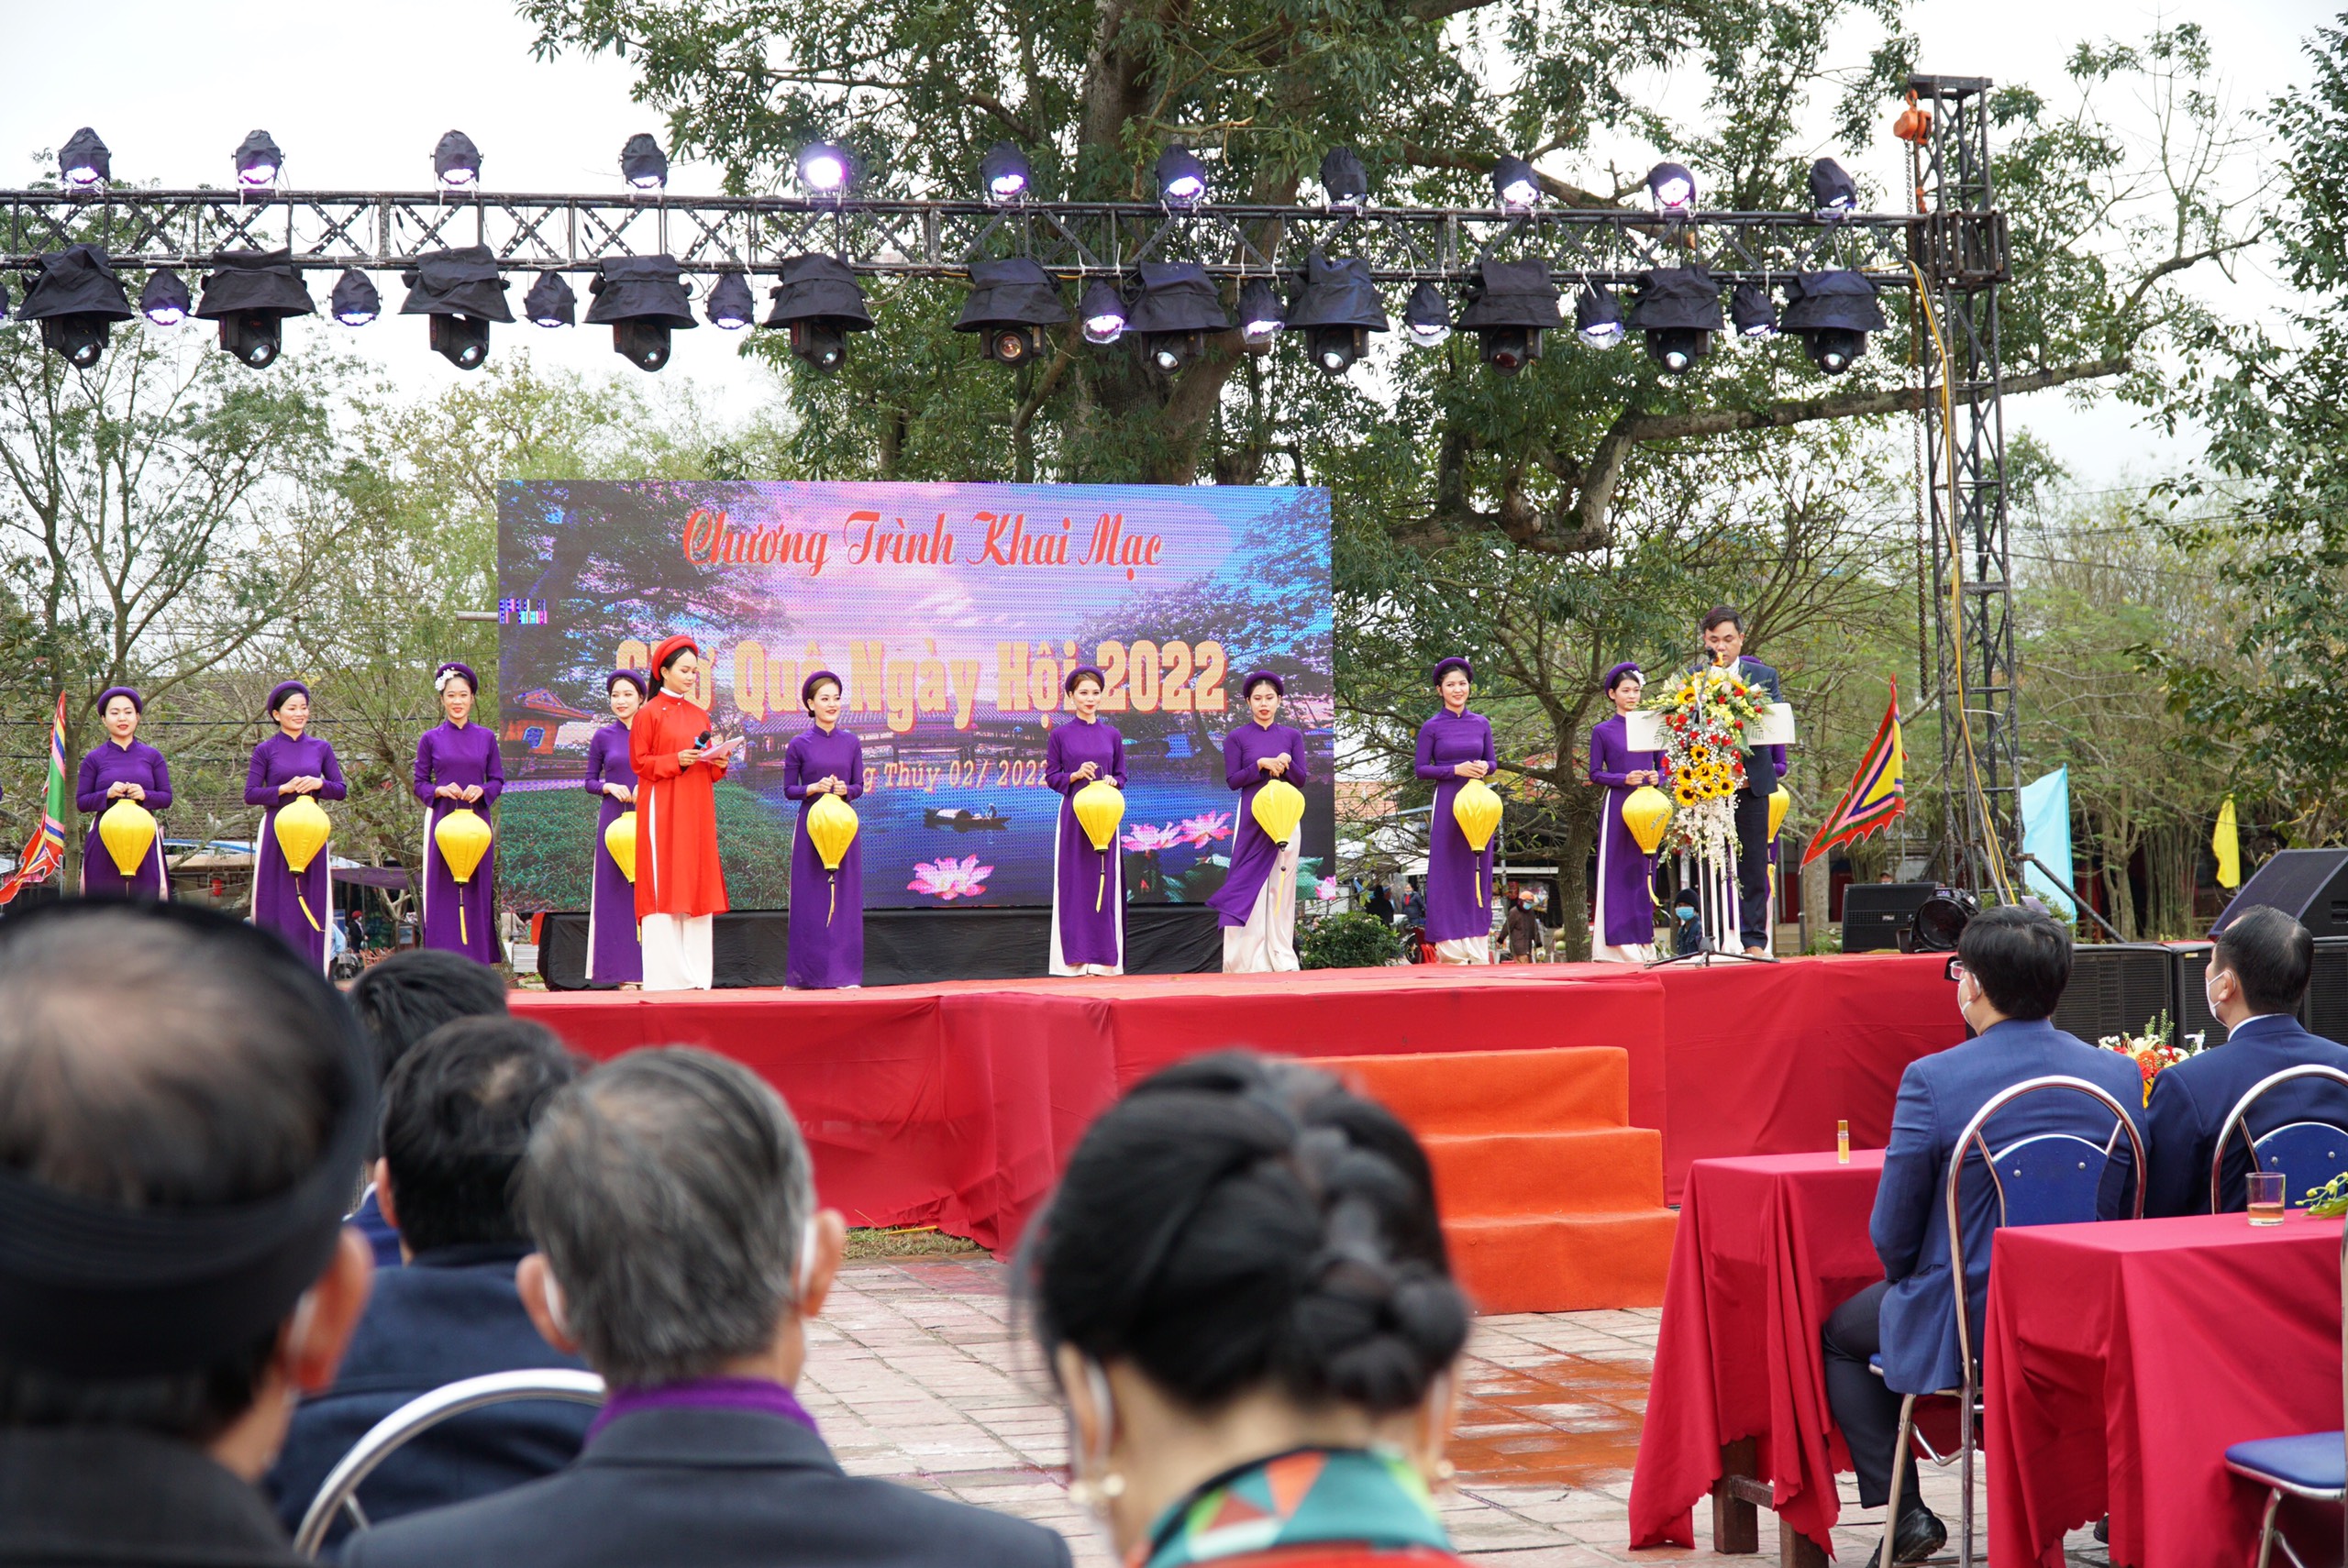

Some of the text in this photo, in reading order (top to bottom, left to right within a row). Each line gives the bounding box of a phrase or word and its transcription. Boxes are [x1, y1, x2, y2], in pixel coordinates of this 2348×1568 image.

[682, 509, 1162, 581] Chương Trình Khai Mạc
[849, 637, 980, 732] Ngày
[997, 640, 1079, 730] Hội
[1096, 639, 1227, 714] 2022
